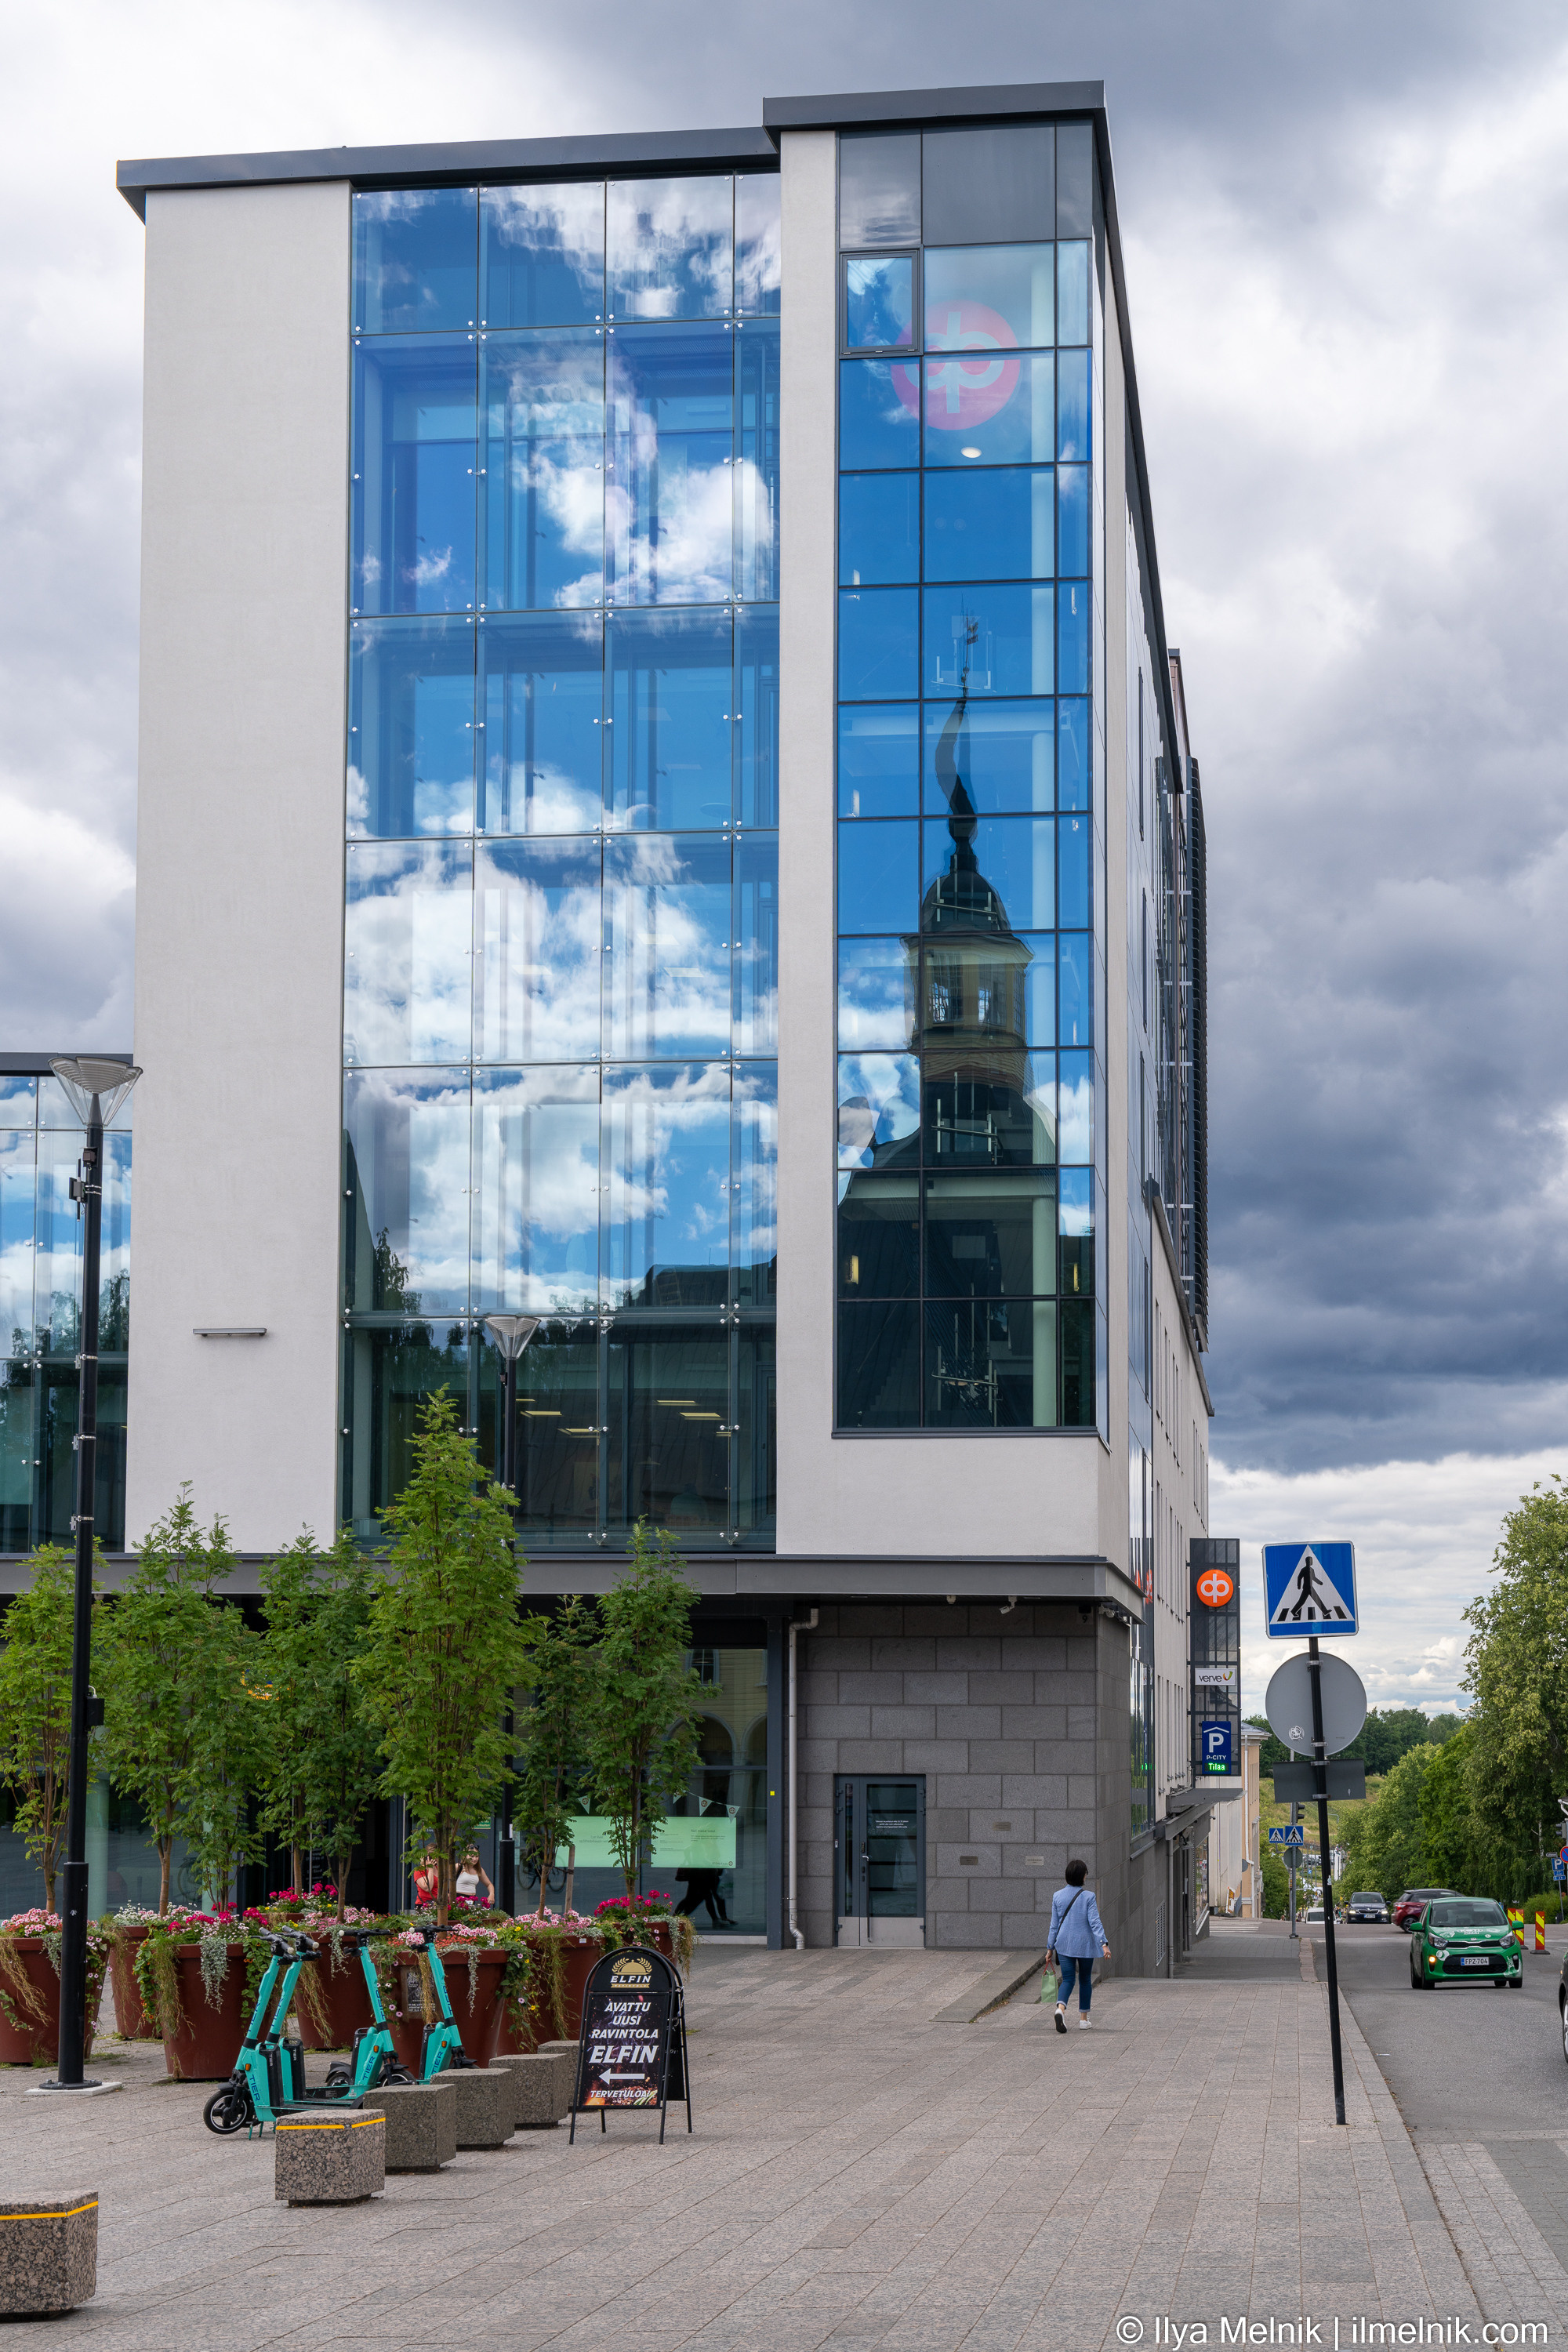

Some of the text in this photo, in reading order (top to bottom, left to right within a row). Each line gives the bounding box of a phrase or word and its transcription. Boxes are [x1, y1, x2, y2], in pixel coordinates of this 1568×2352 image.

[1208, 1733, 1224, 1753] P
[604, 2002, 652, 2012] AVATTU
[612, 2015, 642, 2025] UUSI
[590, 2028, 659, 2038] RAVINTOLA
[588, 2045, 659, 2063] ELFIN
[362, 2056, 376, 2081] TIER
[249, 2074, 260, 2101] TIER
